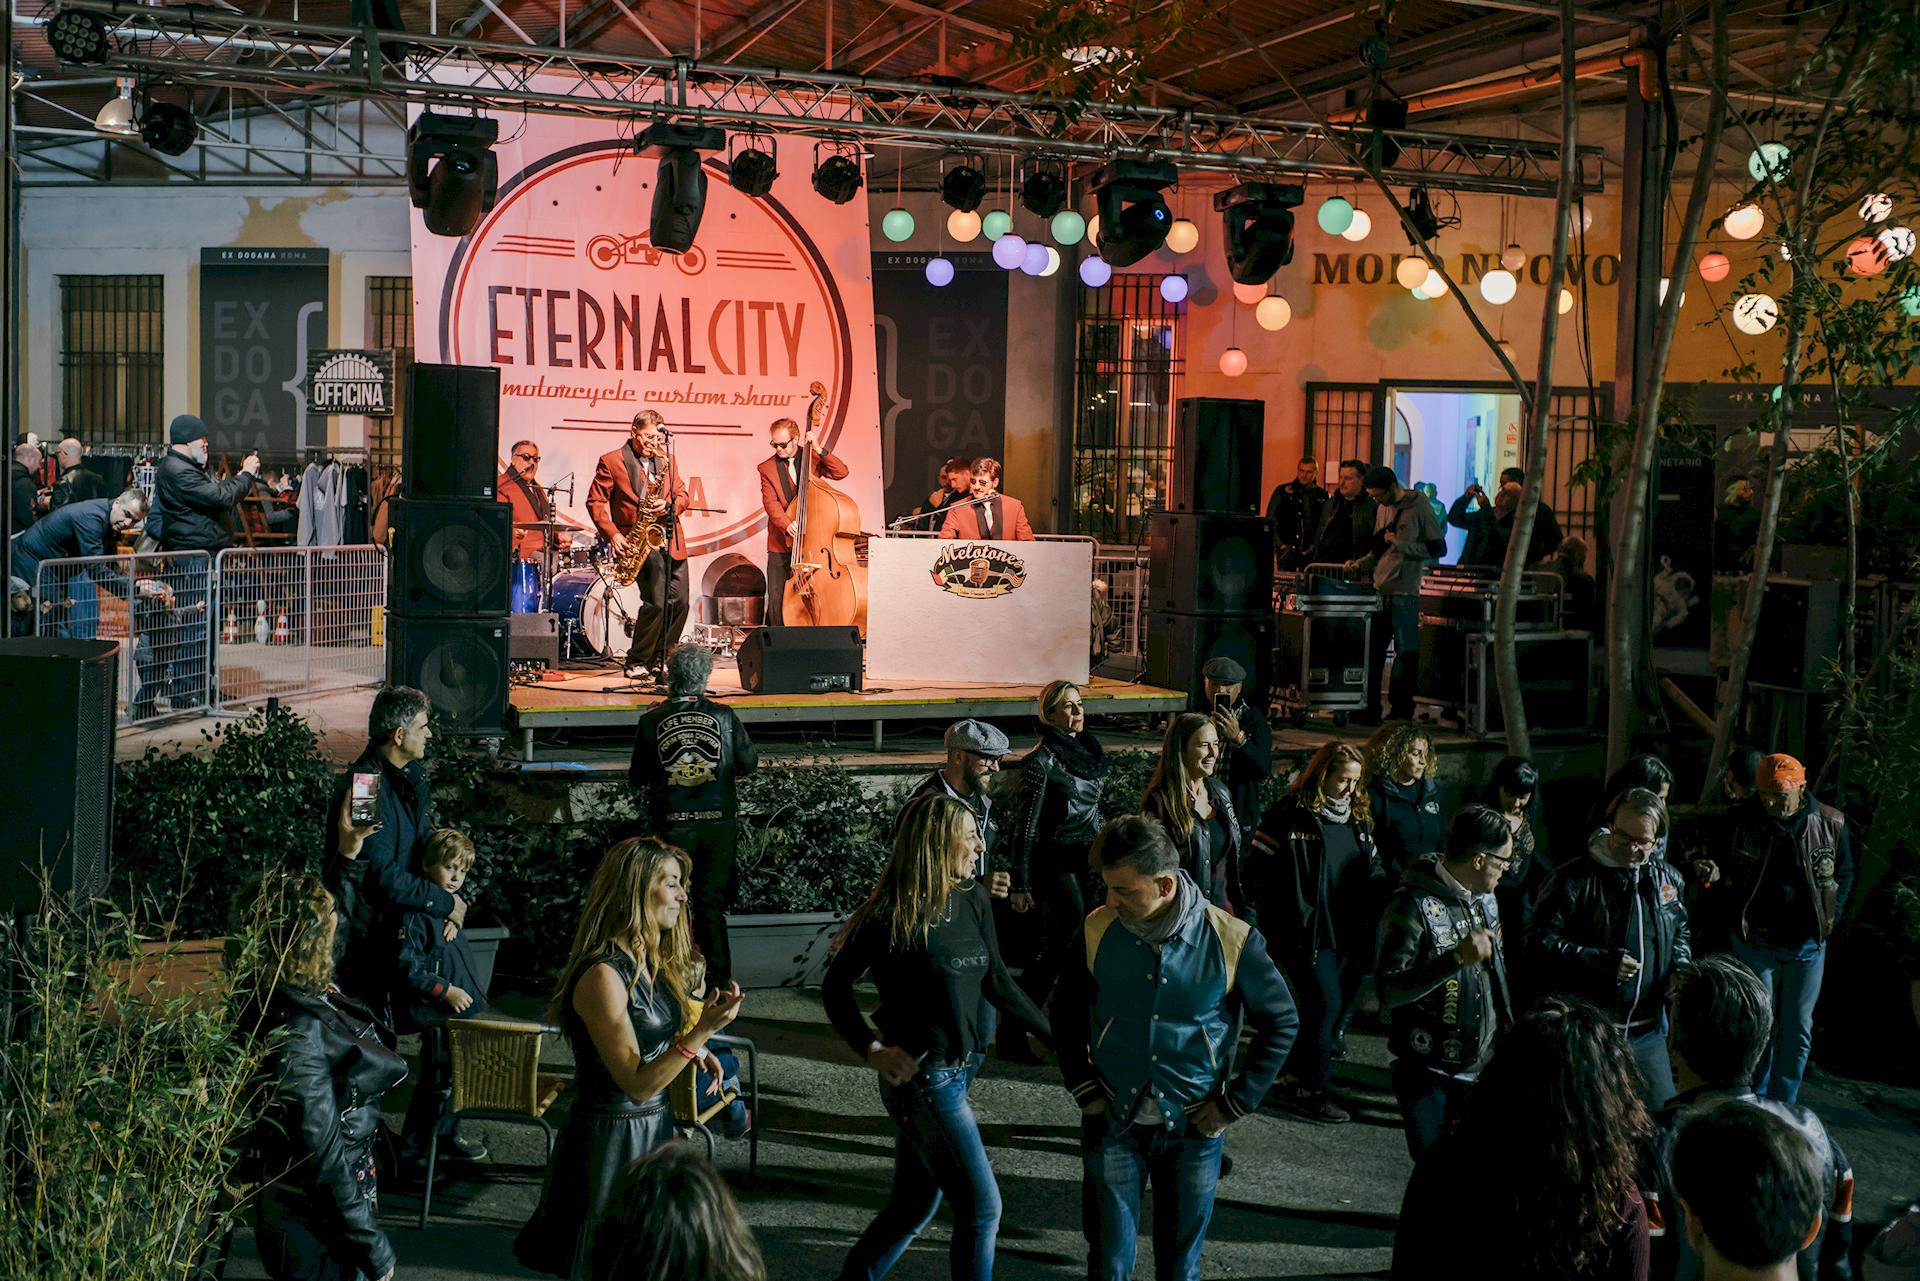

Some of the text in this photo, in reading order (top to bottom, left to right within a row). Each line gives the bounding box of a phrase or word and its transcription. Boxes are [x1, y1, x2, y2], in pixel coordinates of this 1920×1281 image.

[222, 251, 234, 259] EX
[237, 251, 276, 260] DOGANA
[887, 256, 901, 265] EX
[1461, 253, 1620, 287] NOVO
[214, 301, 271, 339] EX
[928, 316, 991, 359] EX
[214, 345, 272, 383] DO
[314, 382, 385, 407] OFFICINA
[502, 375, 796, 408] motorcycle custom show
[928, 362, 993, 406] DO
[214, 388, 272, 426] GA
[927, 408, 992, 451] GA
[938, 541, 1026, 574] Melotones
[662, 716, 714, 730] LIFE MEMBER
